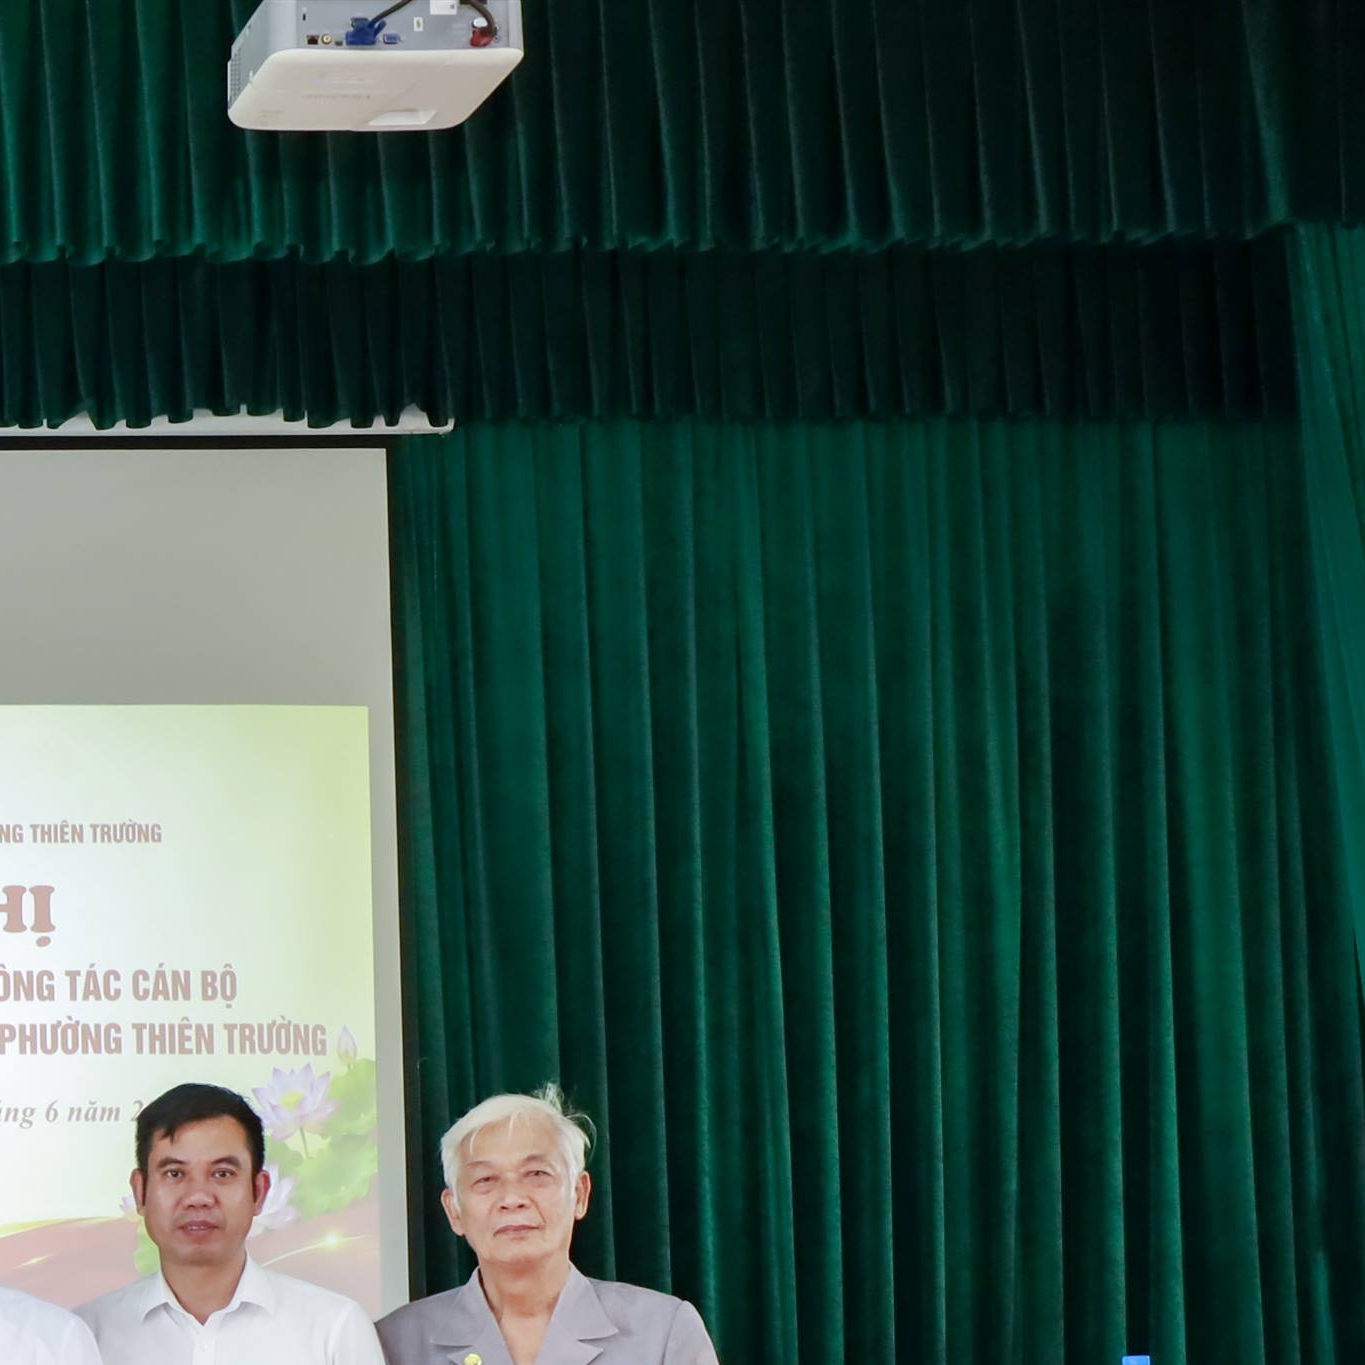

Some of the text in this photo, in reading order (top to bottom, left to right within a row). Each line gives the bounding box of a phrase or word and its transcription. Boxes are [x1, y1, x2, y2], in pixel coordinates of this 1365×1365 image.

[29, 818, 85, 845] THIÊN
[89, 818, 163, 845] TRƯỜNG
[64, 962, 122, 1002] TÁC
[132, 962, 192, 1001] CÁN
[201, 962, 237, 1009] BỘ
[131, 1016, 215, 1055] THIÊN
[223, 1015, 328, 1057] TRƯỜNG
[45, 1099, 60, 1124] 6
[67, 1100, 121, 1123] năm
